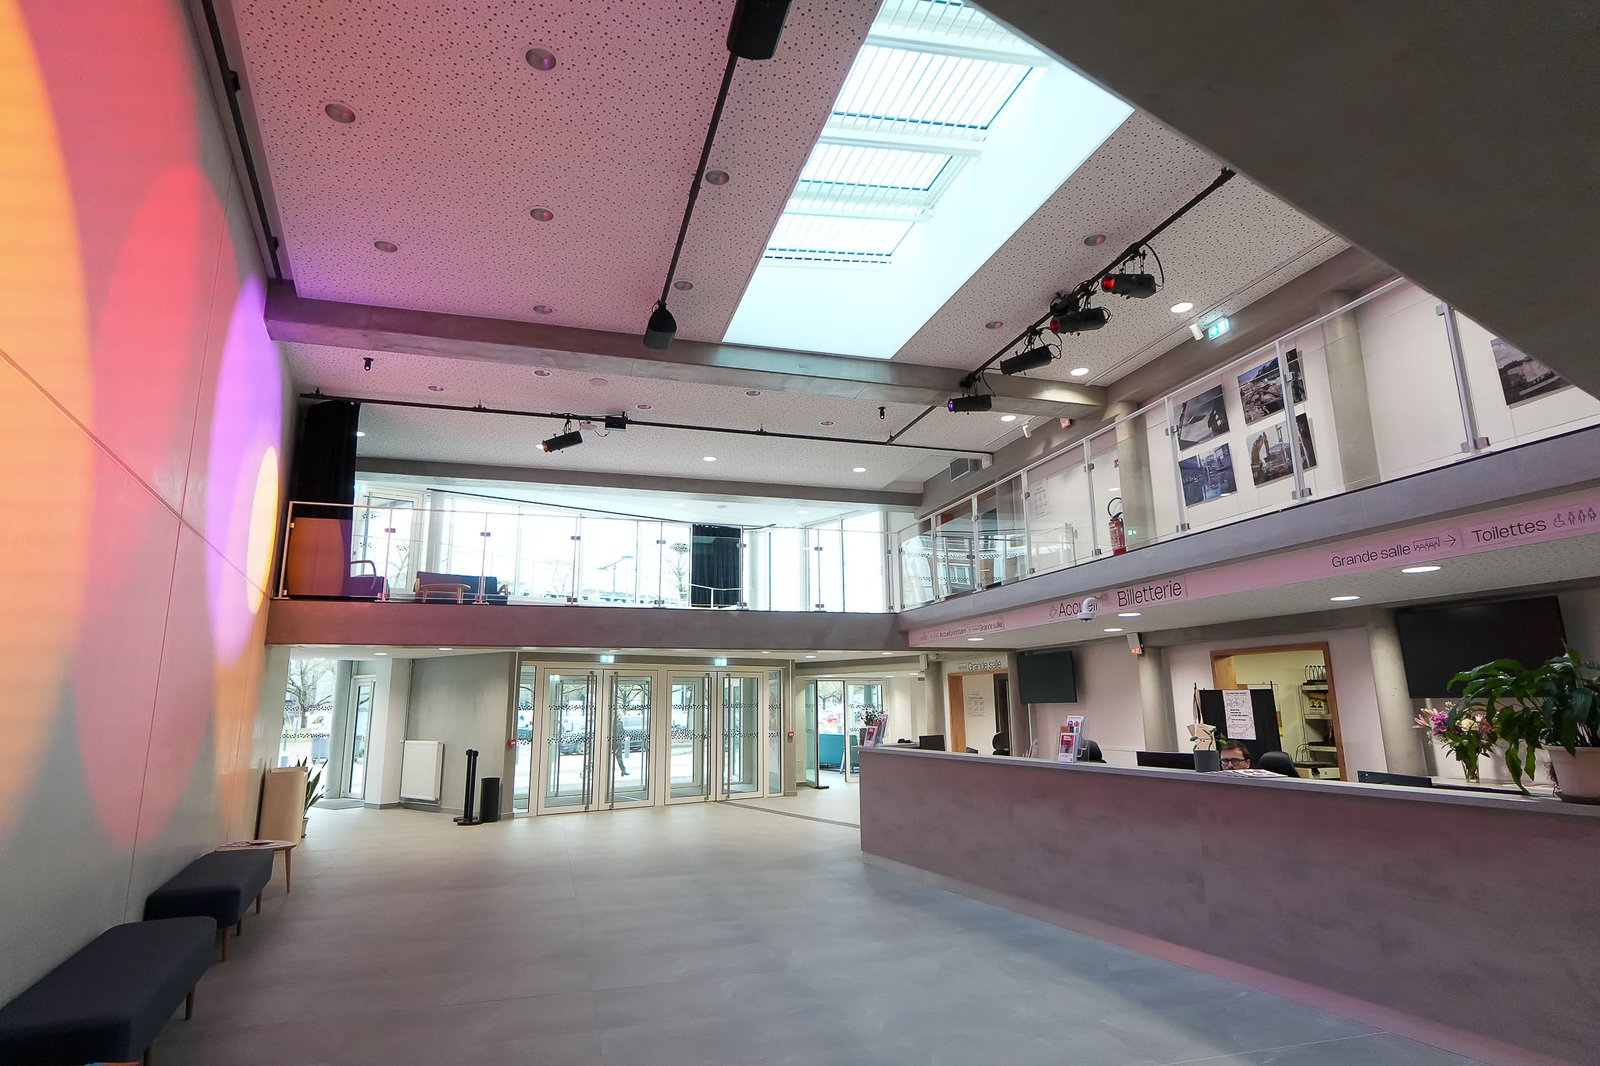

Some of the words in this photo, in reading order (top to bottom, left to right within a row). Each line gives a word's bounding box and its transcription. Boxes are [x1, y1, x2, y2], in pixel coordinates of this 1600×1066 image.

[1471, 518, 1547, 544] Toilettes
[1331, 546, 1378, 568] Grande
[1380, 544, 1411, 559] salle
[1117, 580, 1182, 608] Billetterie
[968, 661, 988, 671] Grande
[988, 659, 1001, 669] salle
